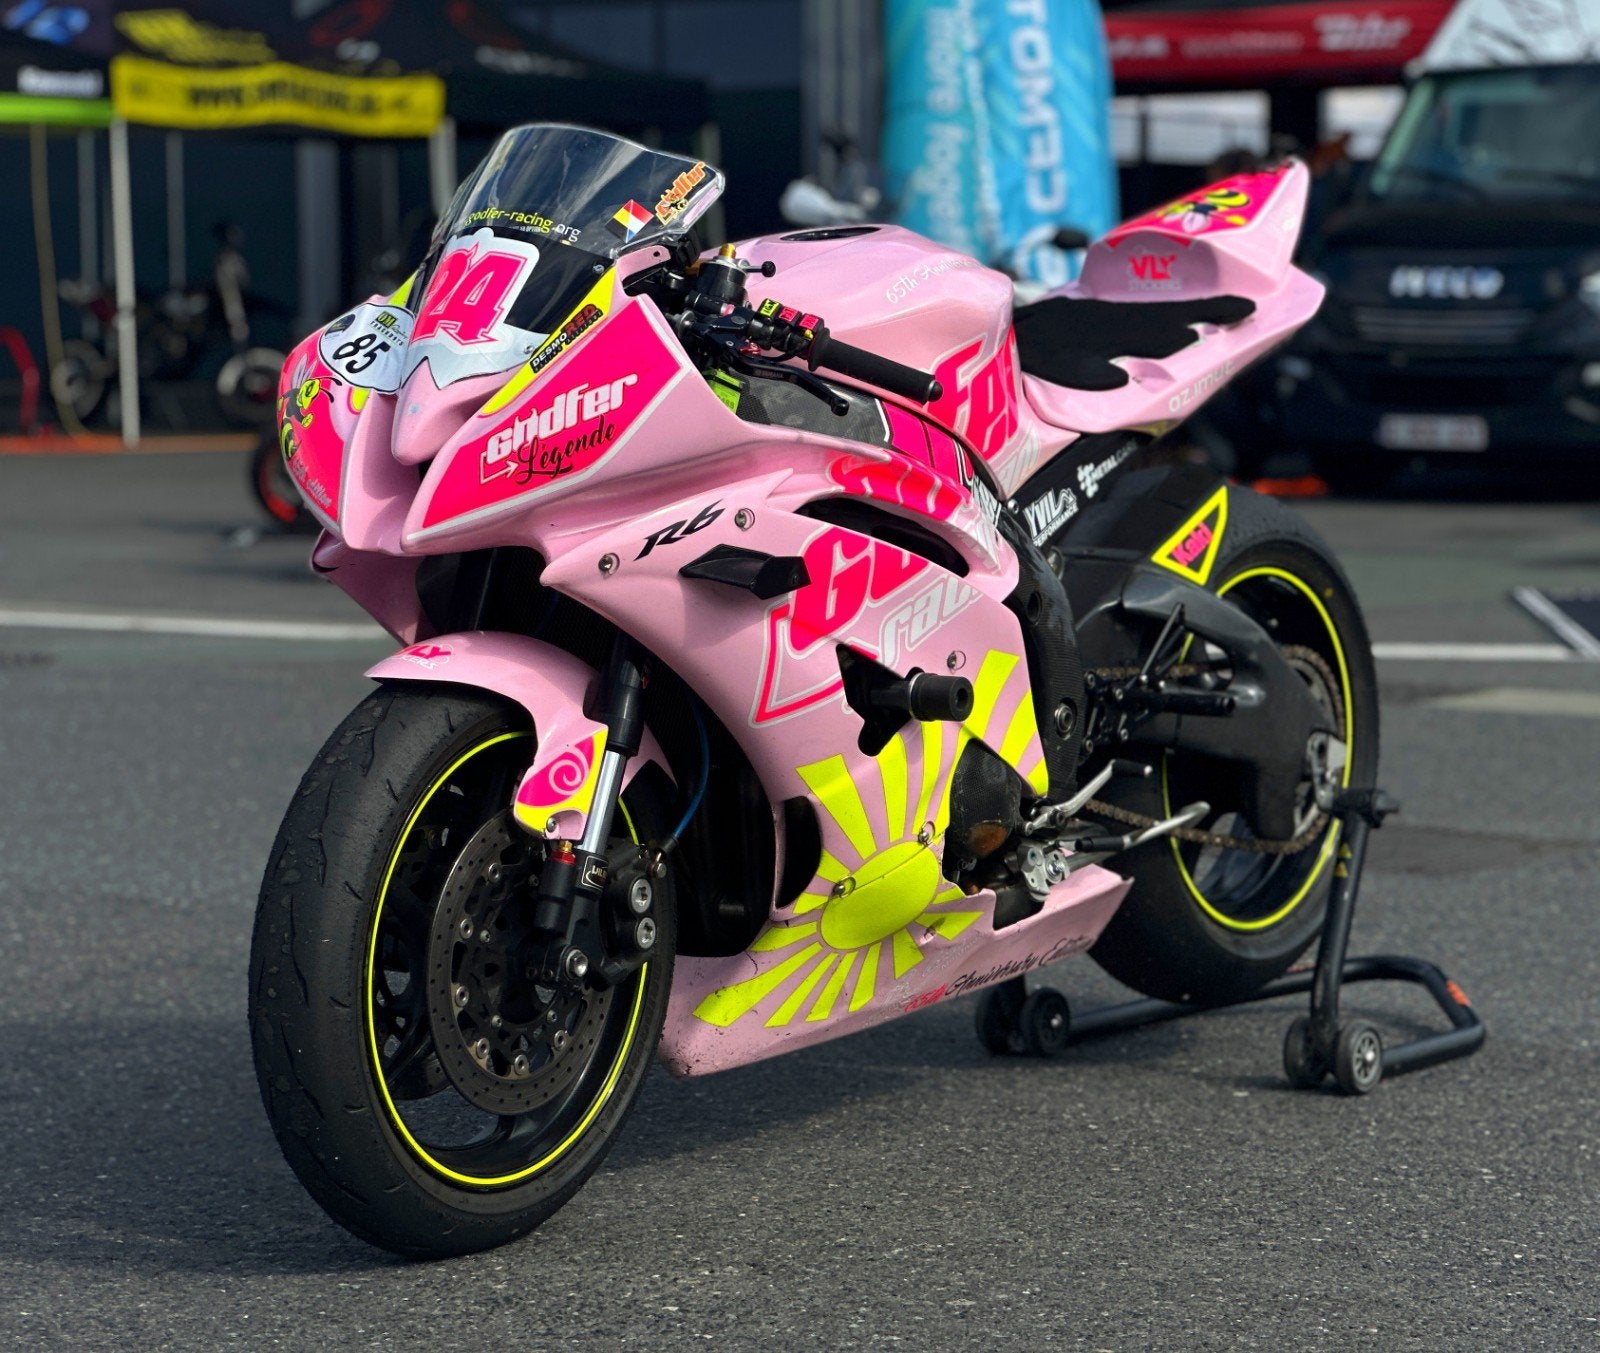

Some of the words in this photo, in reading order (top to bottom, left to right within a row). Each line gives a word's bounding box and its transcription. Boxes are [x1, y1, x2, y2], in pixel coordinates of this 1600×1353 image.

[464, 206, 581, 243] godfer-racing.org
[1128, 253, 1177, 280] VLY
[332, 333, 391, 374] 85
[633, 498, 726, 561] R6
[1033, 502, 1079, 547] PERFORMANCE
